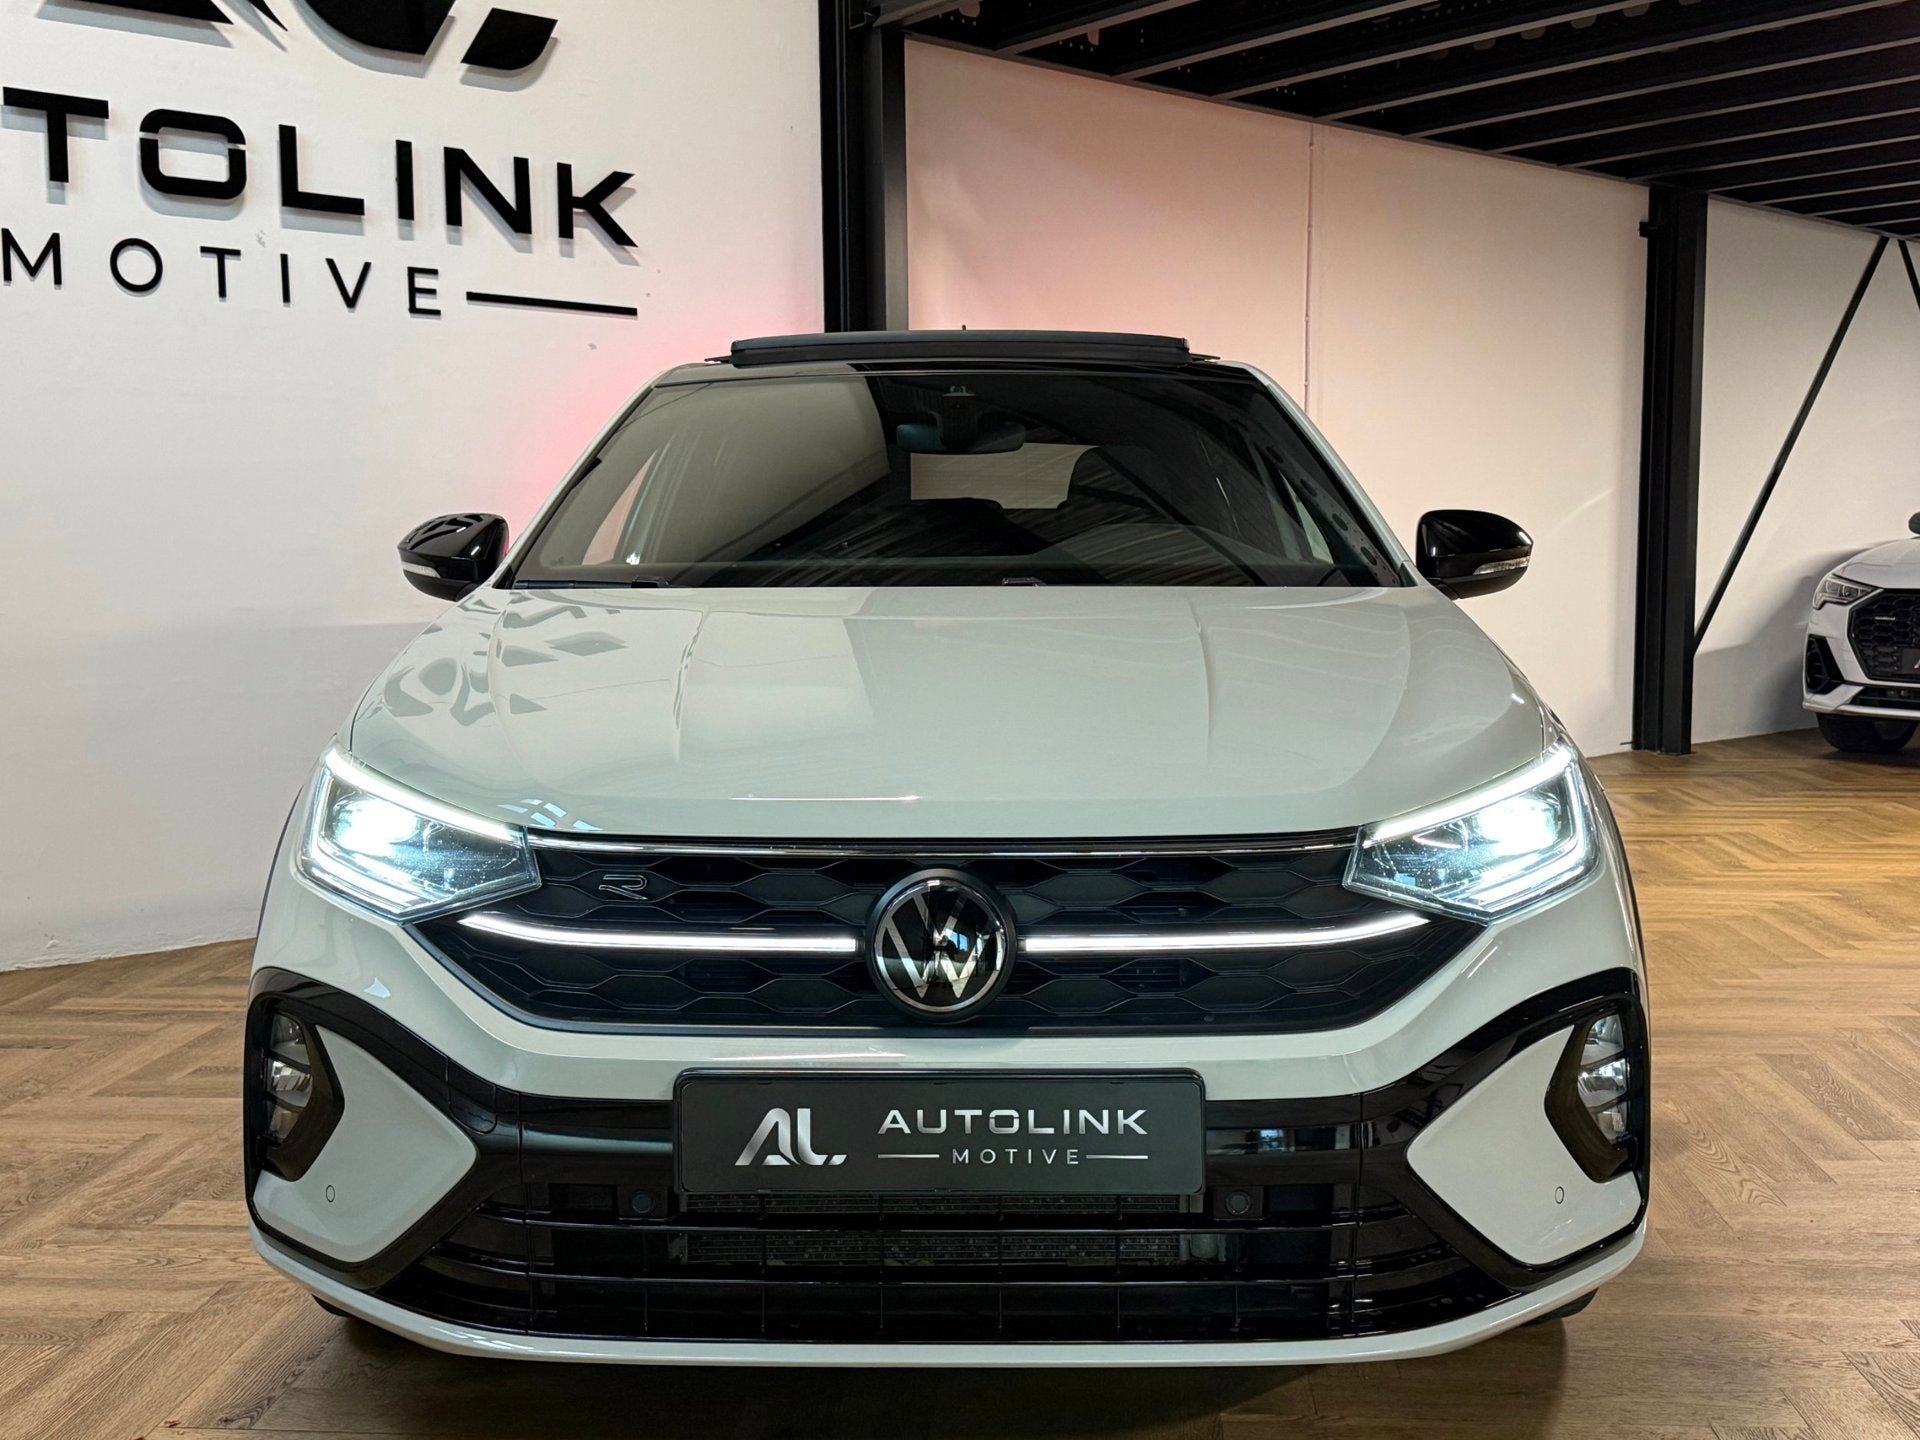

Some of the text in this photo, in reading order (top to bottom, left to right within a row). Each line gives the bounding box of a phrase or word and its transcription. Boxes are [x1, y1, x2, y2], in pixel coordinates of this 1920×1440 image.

[1, 228, 441, 316] MOTIVE
[877, 1109, 1148, 1135] AUTOLINK
[952, 1148, 1079, 1165] MOTIVE
